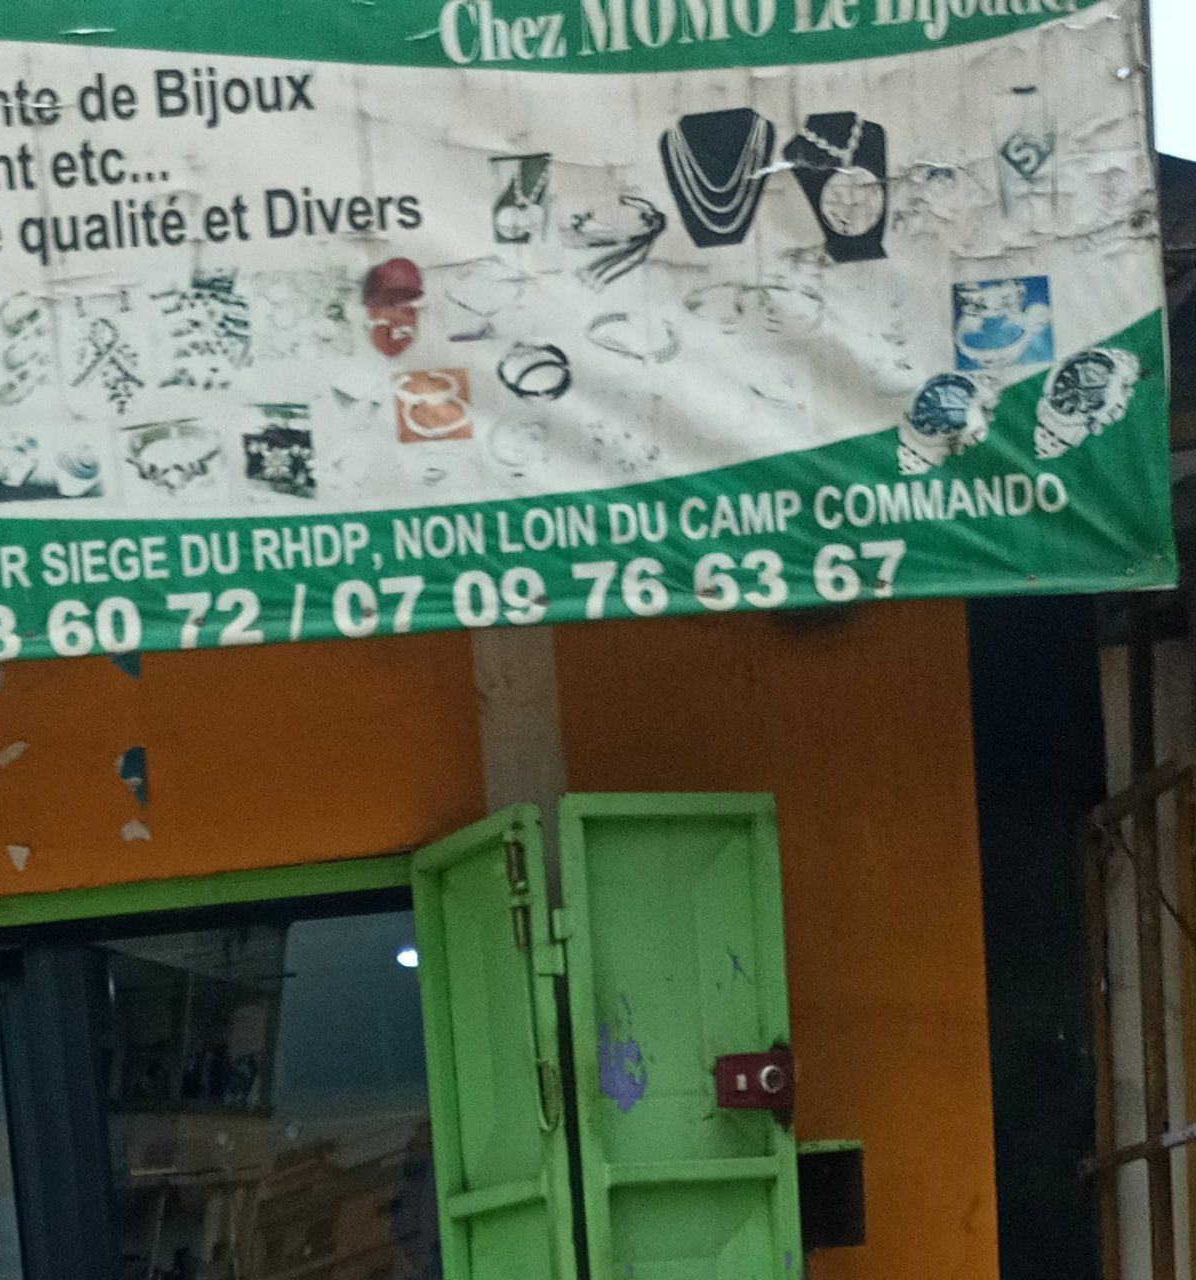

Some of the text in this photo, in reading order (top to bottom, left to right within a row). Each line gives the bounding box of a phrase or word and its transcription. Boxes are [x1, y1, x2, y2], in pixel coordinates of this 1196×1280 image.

[438, 0, 567, 64] Chez
[577, 0, 776, 55] MOMO
[78, 73, 138, 123] de
[154, 67, 316, 129] Bijoux
[52, 140, 170, 189] etc...
[20, 195, 186, 266] qualité
[204, 194, 251, 242] et
[265, 186, 423, 238] Divers
[41, 537, 171, 586] SIEGE
[179, 531, 239, 577] DU
[393, 511, 487, 560] NON
[496, 503, 598, 552] LOIN
[607, 501, 669, 545] DU
[678, 489, 803, 540] CAMP
[813, 472, 1069, 530] COMMANDO
[47, 596, 142, 657] 60
[166, 588, 265, 650] 72
[289, 582, 307, 643] /
[332, 575, 425, 638] 07
[452, 566, 550, 627] 09
[571, 557, 670, 617] 76
[693, 549, 789, 611] 63
[813, 538, 907, 602] 67
